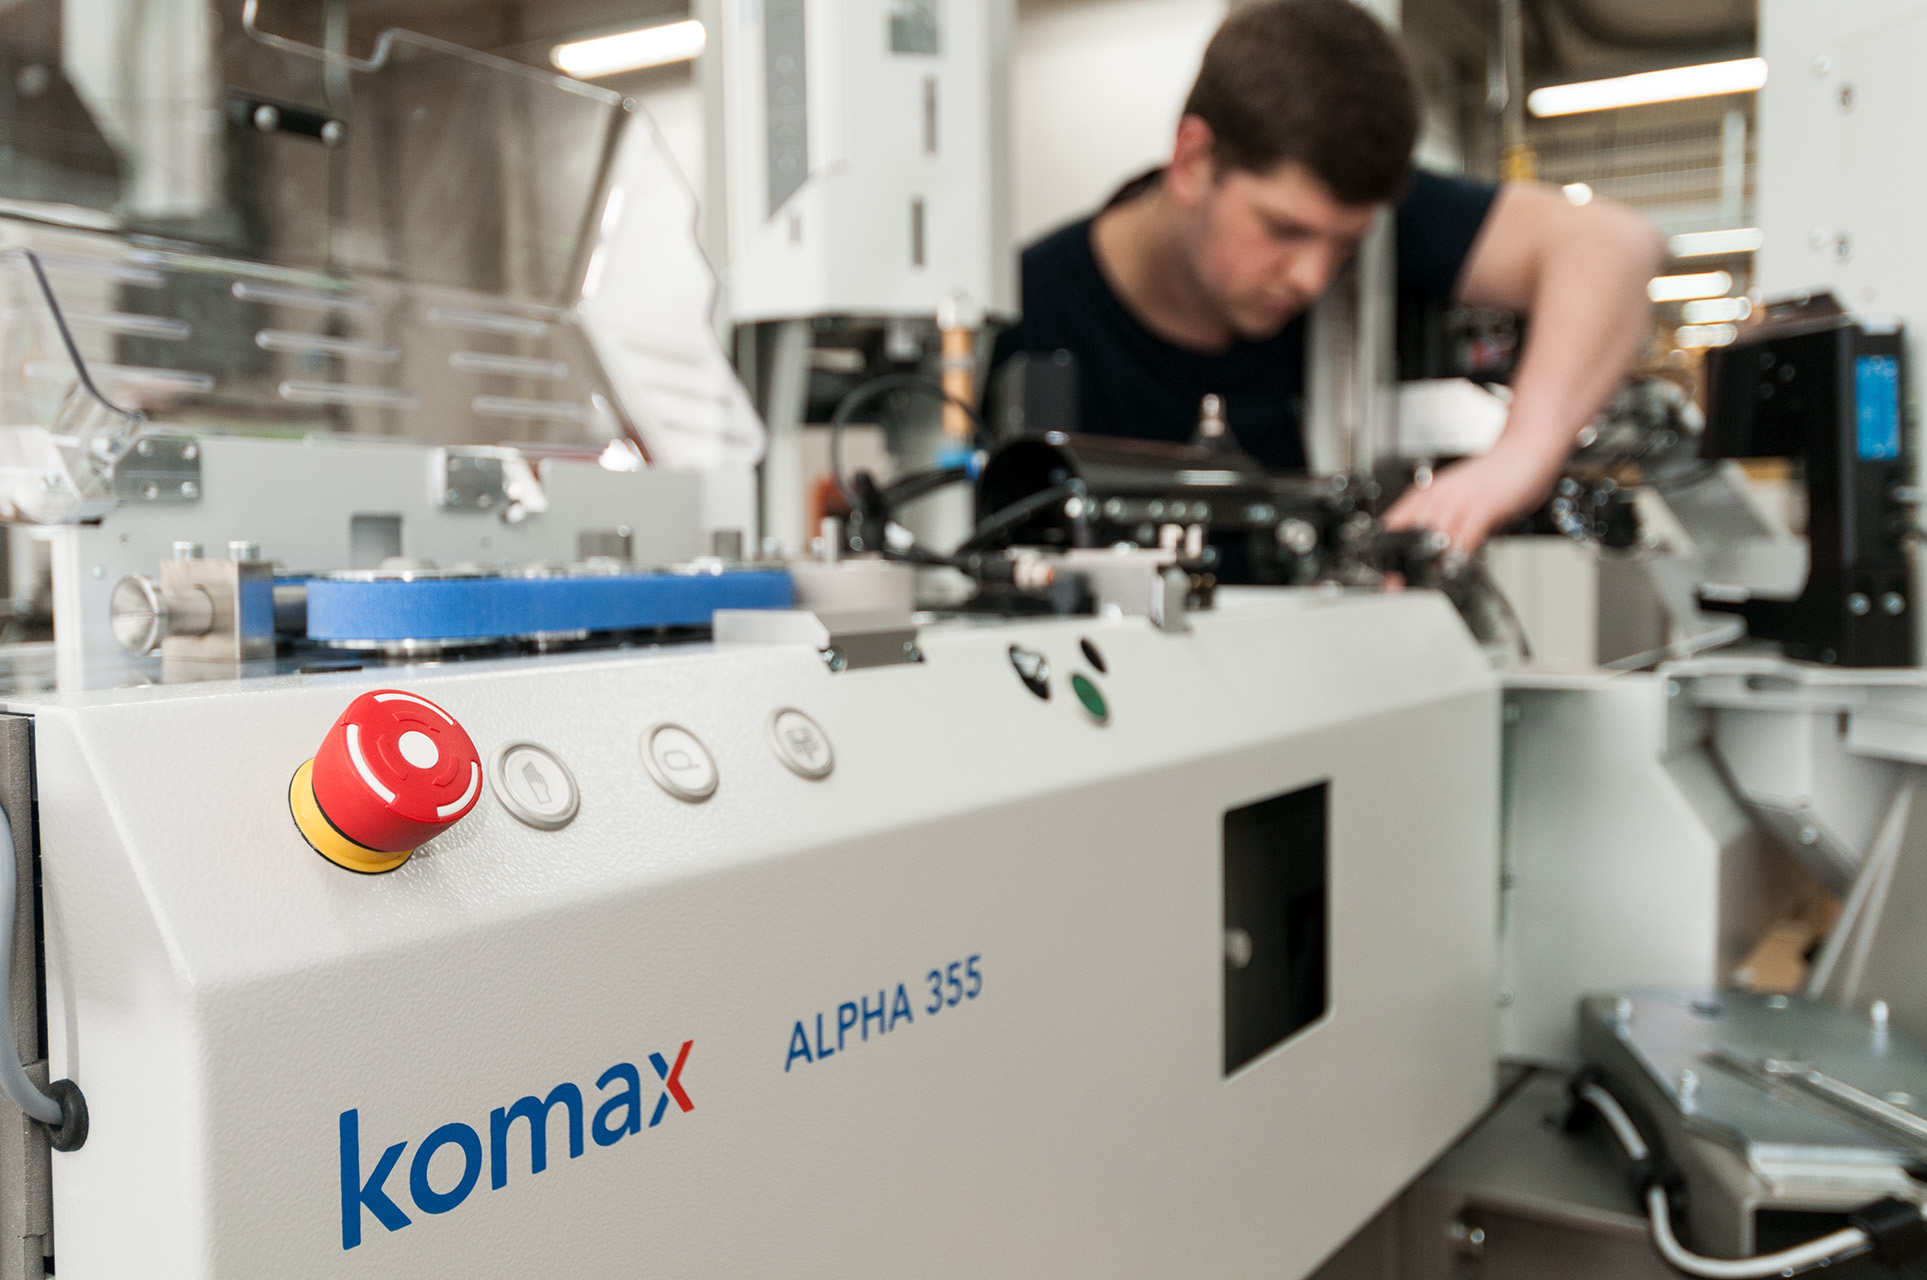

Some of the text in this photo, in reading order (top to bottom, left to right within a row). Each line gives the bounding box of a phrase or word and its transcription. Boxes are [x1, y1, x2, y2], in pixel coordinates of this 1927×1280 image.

[784, 954, 984, 1073] ALPHA 355
[339, 1039, 695, 1251] komax
